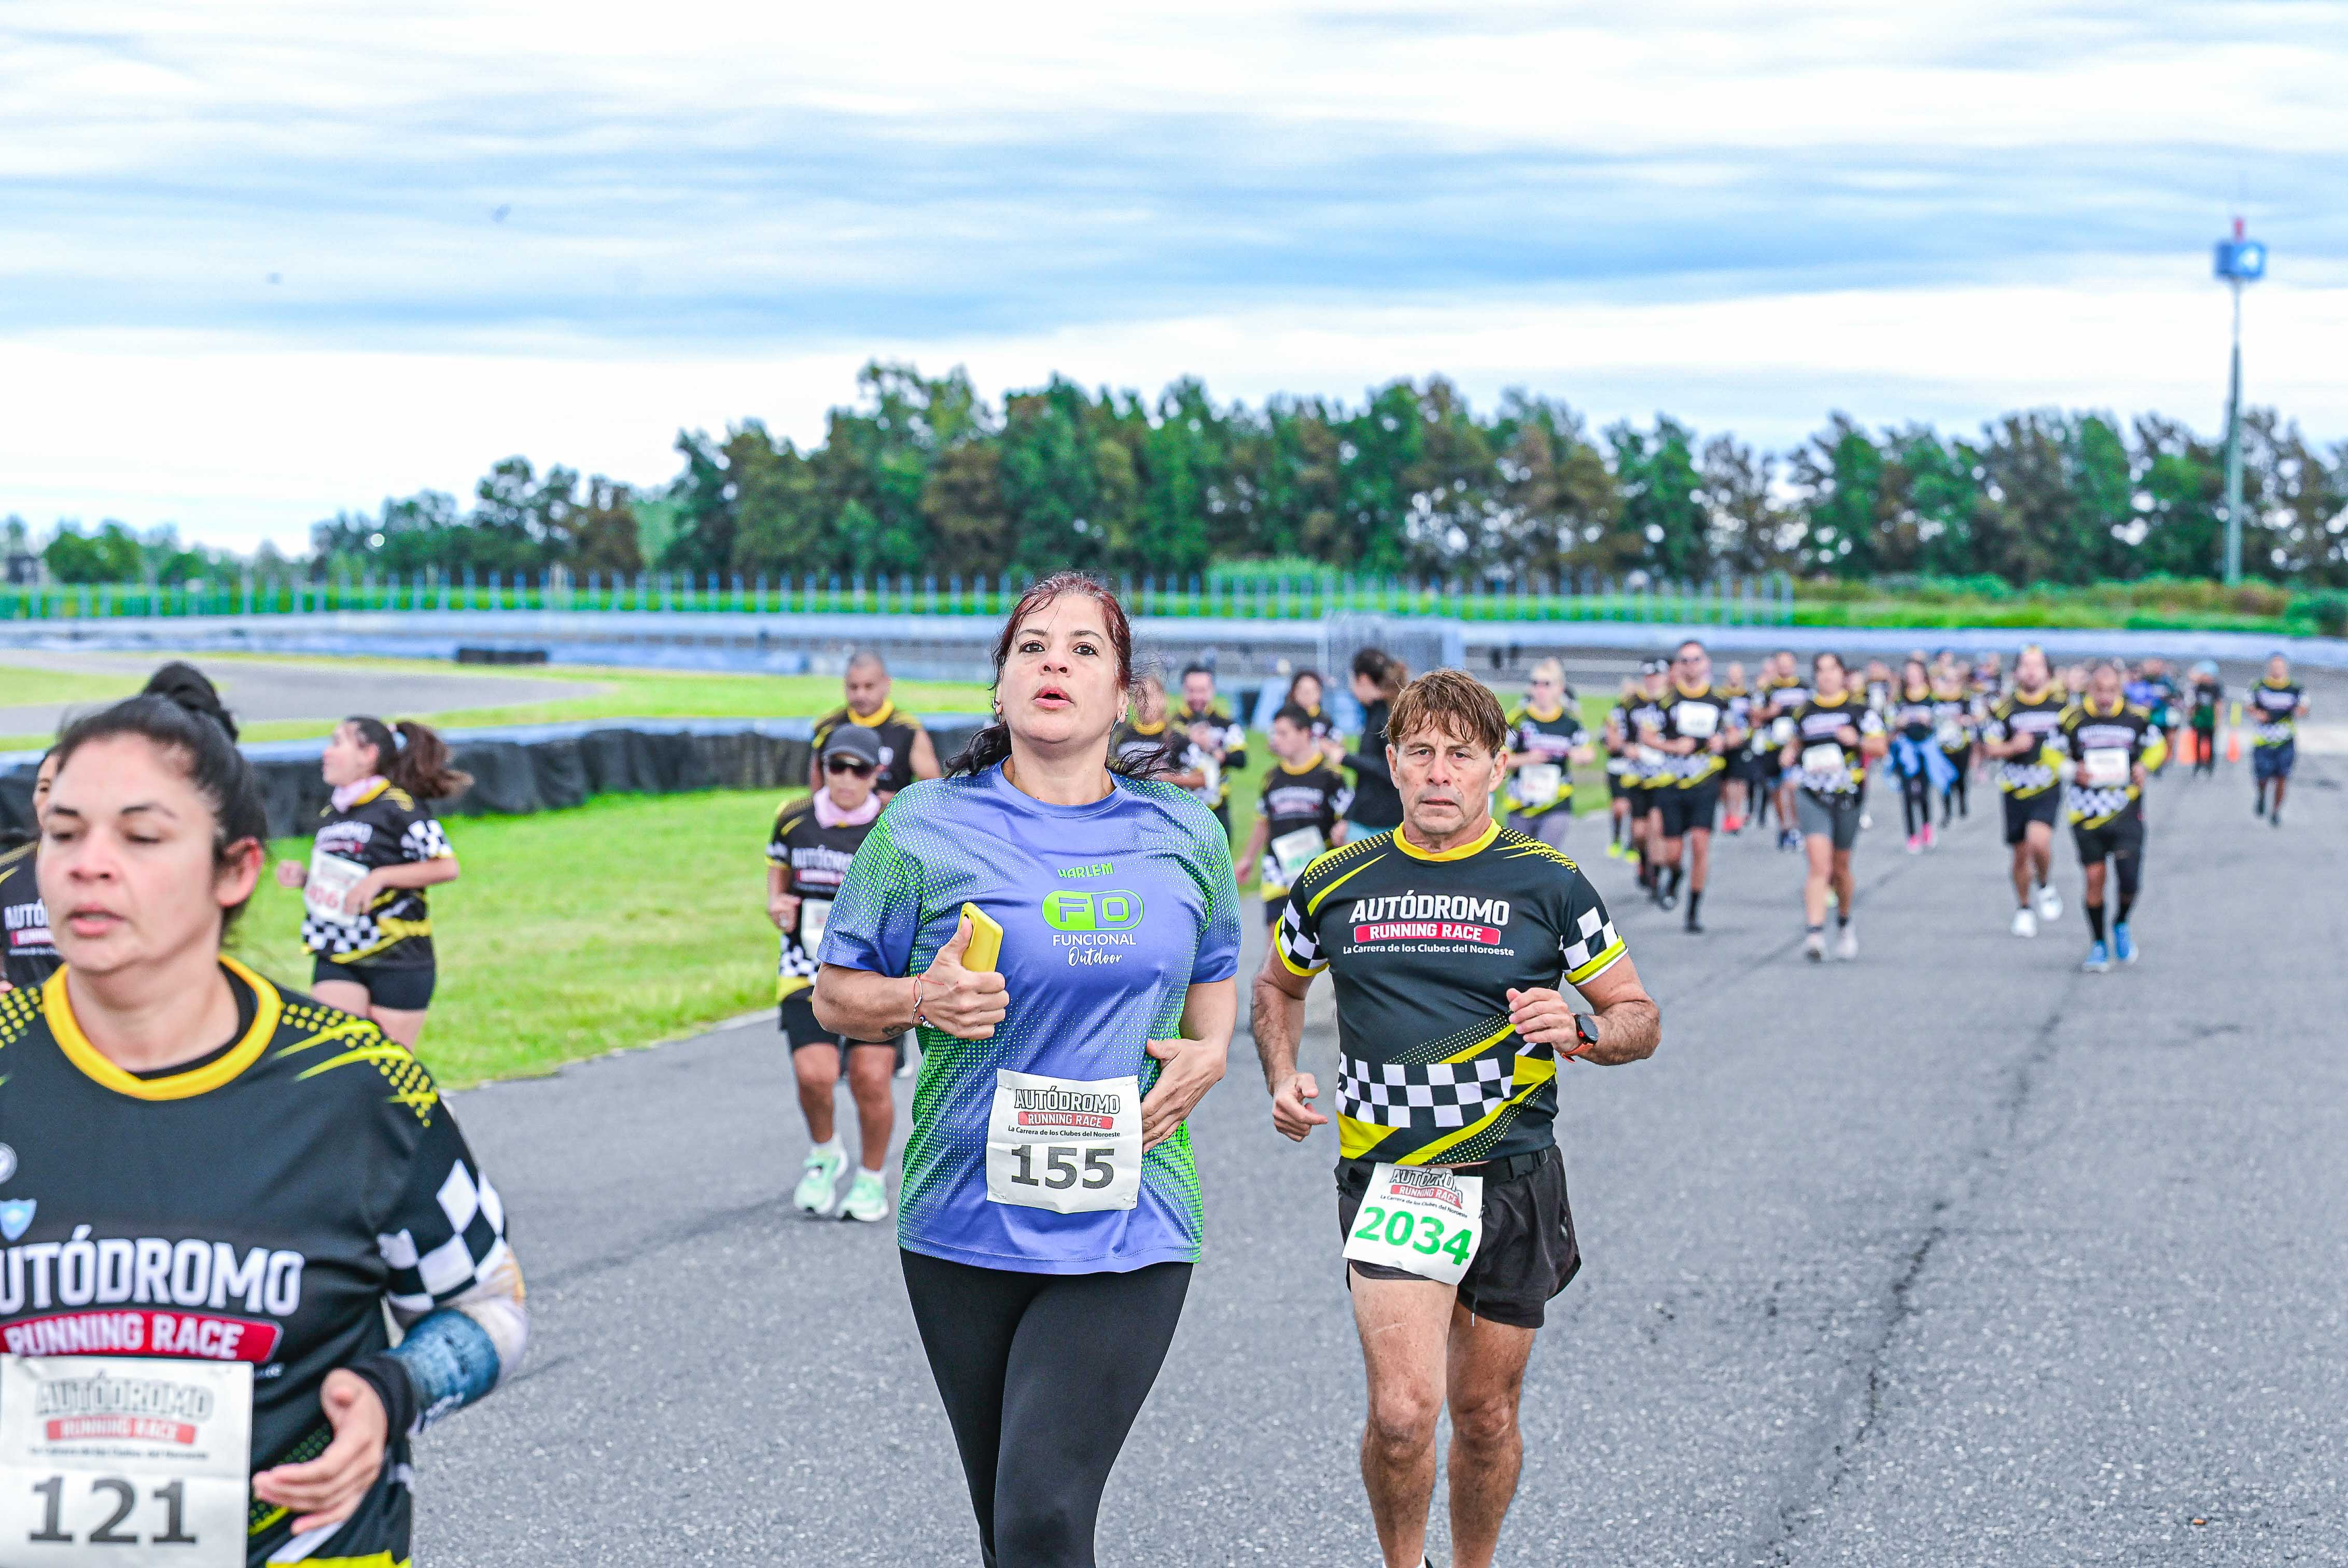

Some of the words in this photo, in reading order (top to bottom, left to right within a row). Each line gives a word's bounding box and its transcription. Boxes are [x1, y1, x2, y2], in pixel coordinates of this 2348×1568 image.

[1057, 862, 1114, 878] HARLEM
[1348, 889, 1510, 926] AUTÓDROMO
[1053, 934, 1137, 946] FUNCIONAL
[1369, 923, 1437, 940] RUNNING
[1442, 924, 1483, 941] RACE
[1068, 946, 1123, 967] Outdoor
[1343, 946, 1352, 955] La
[1353, 944, 1386, 953] Carrera
[1387, 944, 1400, 953] de
[1402, 944, 1416, 953] los
[1418, 944, 1450, 953] Clubes
[1452, 944, 1468, 954] del
[1470, 945, 1515, 957] Noroeste
[1014, 1085, 1121, 1114] AUTÓDROMO
[1028, 1113, 1073, 1125] RUNNING
[1075, 1115, 1103, 1128] RACE
[1016, 1127, 1039, 1136] Carrera
[1040, 1127, 1048, 1136] de
[1011, 1144, 1115, 1189] 155
[1399, 1185, 1435, 1198] RUNNING
[1435, 1188, 1458, 1205] RACE
[1447, 1207, 1468, 1219] Noroeste
[1354, 1206, 1473, 1266] 2034
[0, 1224, 305, 1317] UTÓDROMO
[152, 1314, 245, 1361] RACE
[29, 1476, 197, 1544] 121
